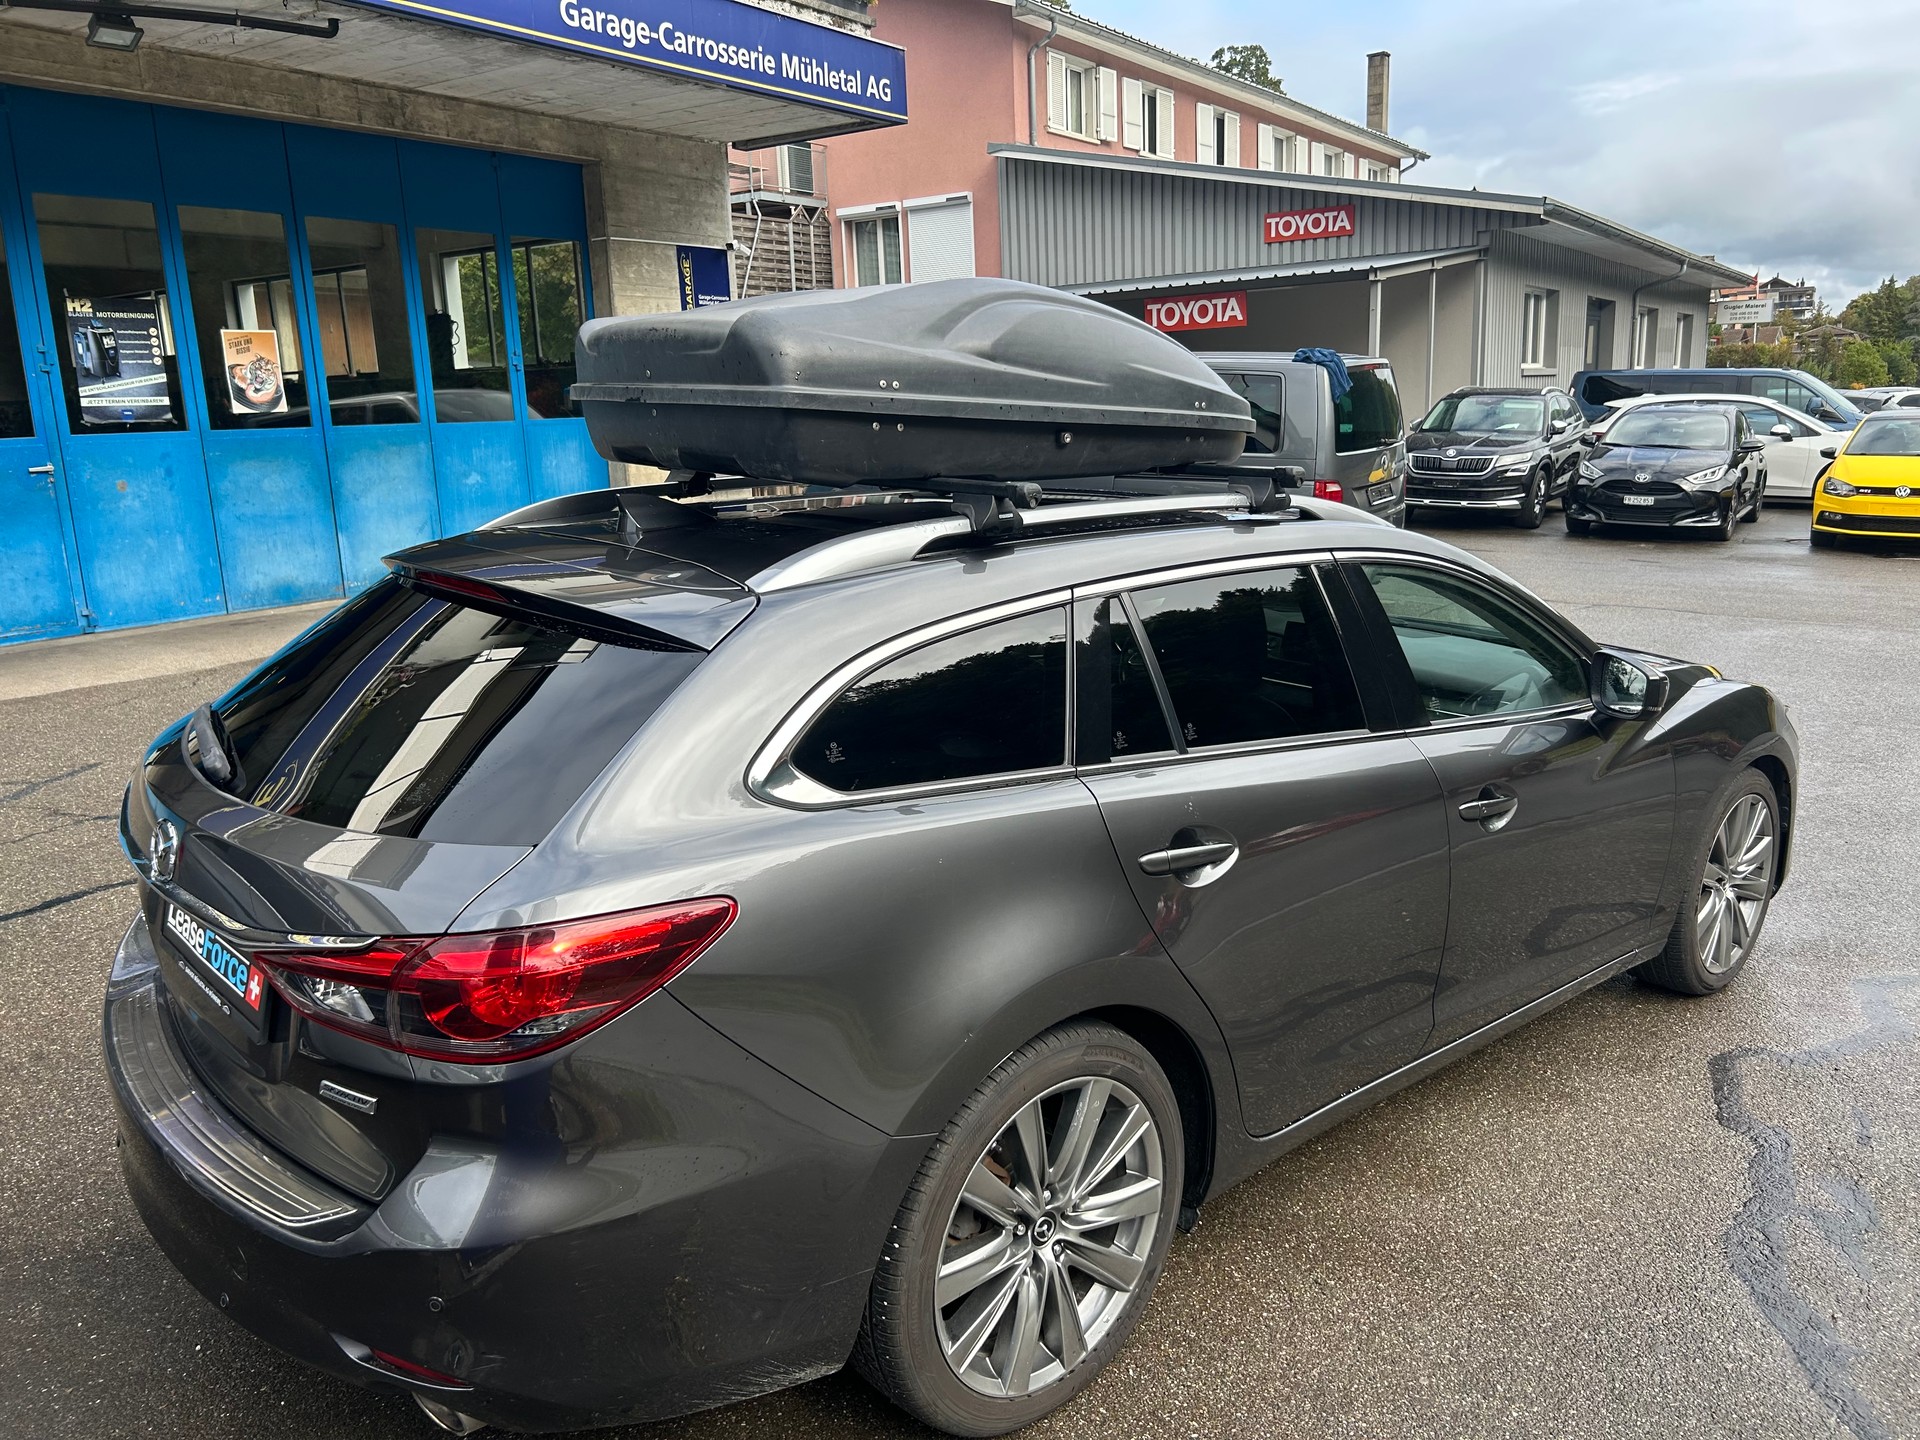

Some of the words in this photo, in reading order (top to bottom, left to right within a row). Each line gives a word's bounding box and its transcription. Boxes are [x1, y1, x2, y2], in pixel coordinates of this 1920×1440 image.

[559, 0, 776, 76] Garage-Carrosserie
[781, 52, 862, 96] Mühletal
[866, 75, 892, 102] AG
[1266, 210, 1352, 238] TOYOTA
[66, 298, 93, 312] H2
[1146, 297, 1244, 327] TOYOTA
[96, 311, 155, 319] MOTORREINIGUNG
[228, 340, 243, 350] STARK
[243, 337, 253, 346] UND
[236, 345, 251, 355] BISSIG
[88, 380, 135, 393] ENTSCHLACKUNGSKUR
[166, 903, 249, 993] LeaseForce
